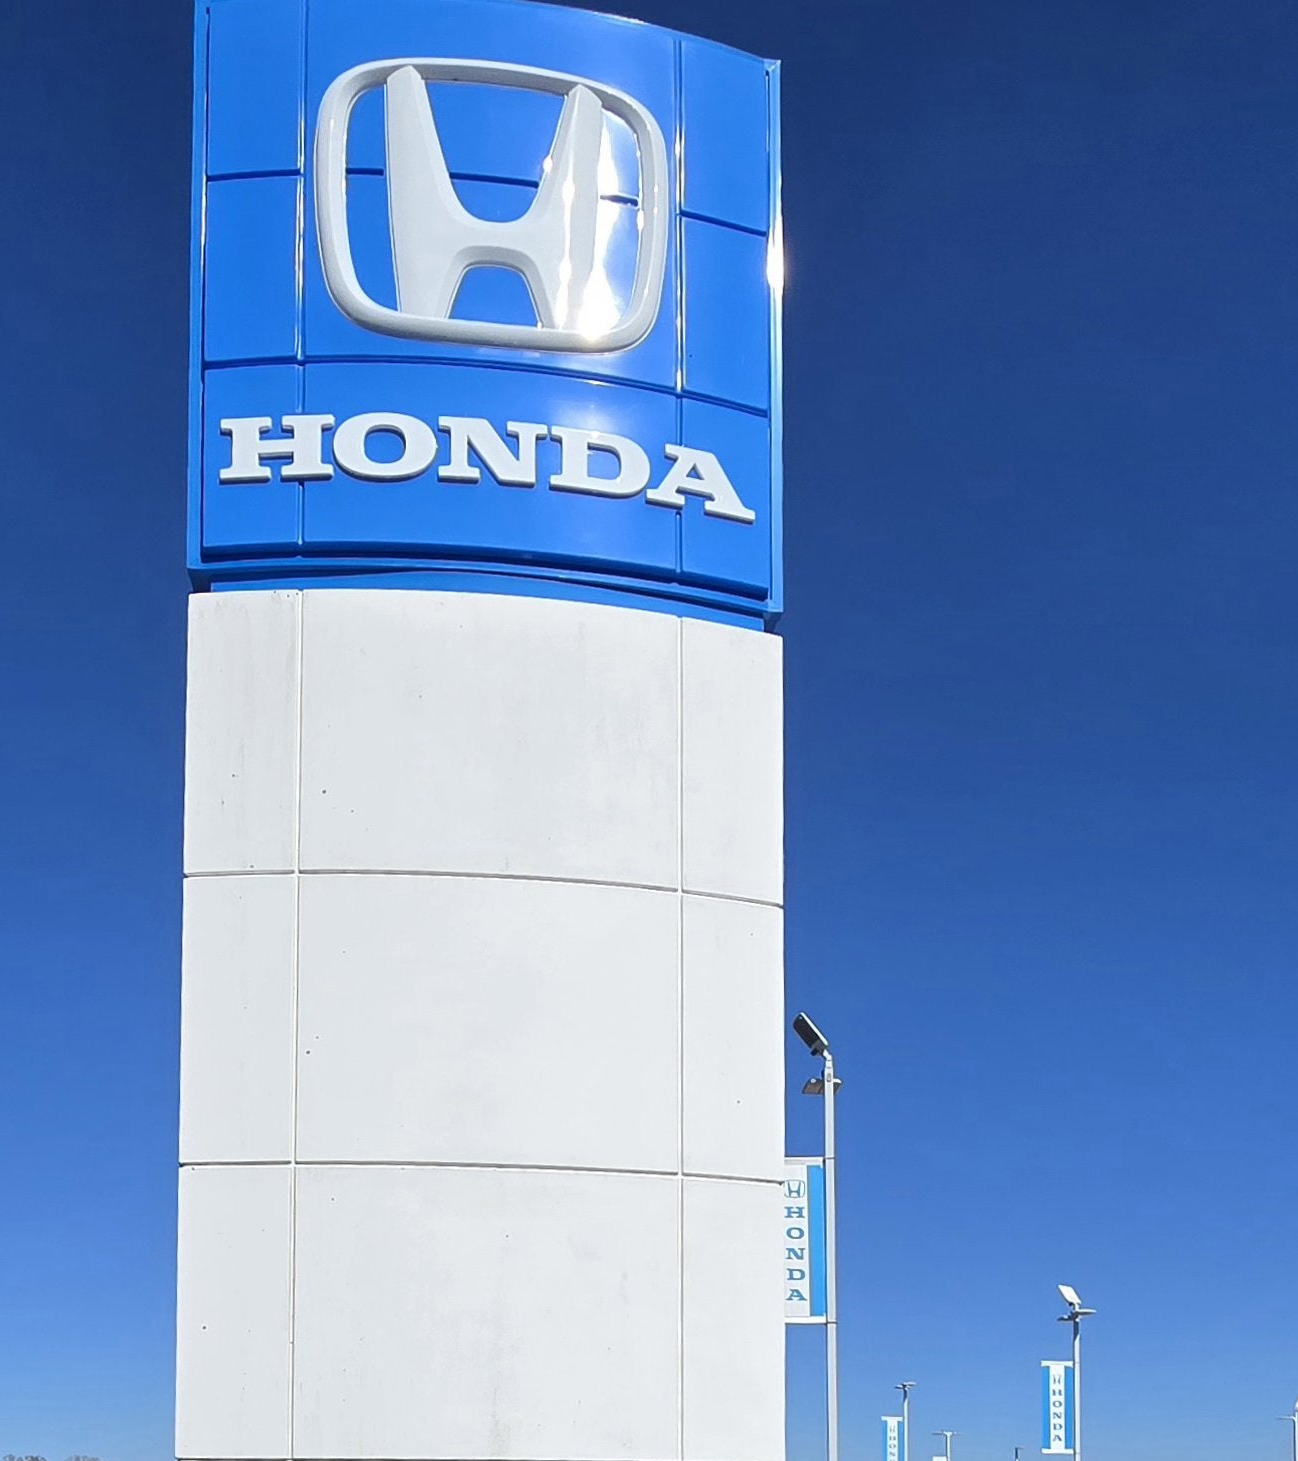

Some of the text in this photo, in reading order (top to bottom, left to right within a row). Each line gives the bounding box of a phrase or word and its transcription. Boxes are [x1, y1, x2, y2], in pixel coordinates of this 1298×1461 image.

[218, 411, 756, 523] HONDA
[784, 1206, 807, 1301] HONDA
[1052, 1388, 1063, 1442] HONDA
